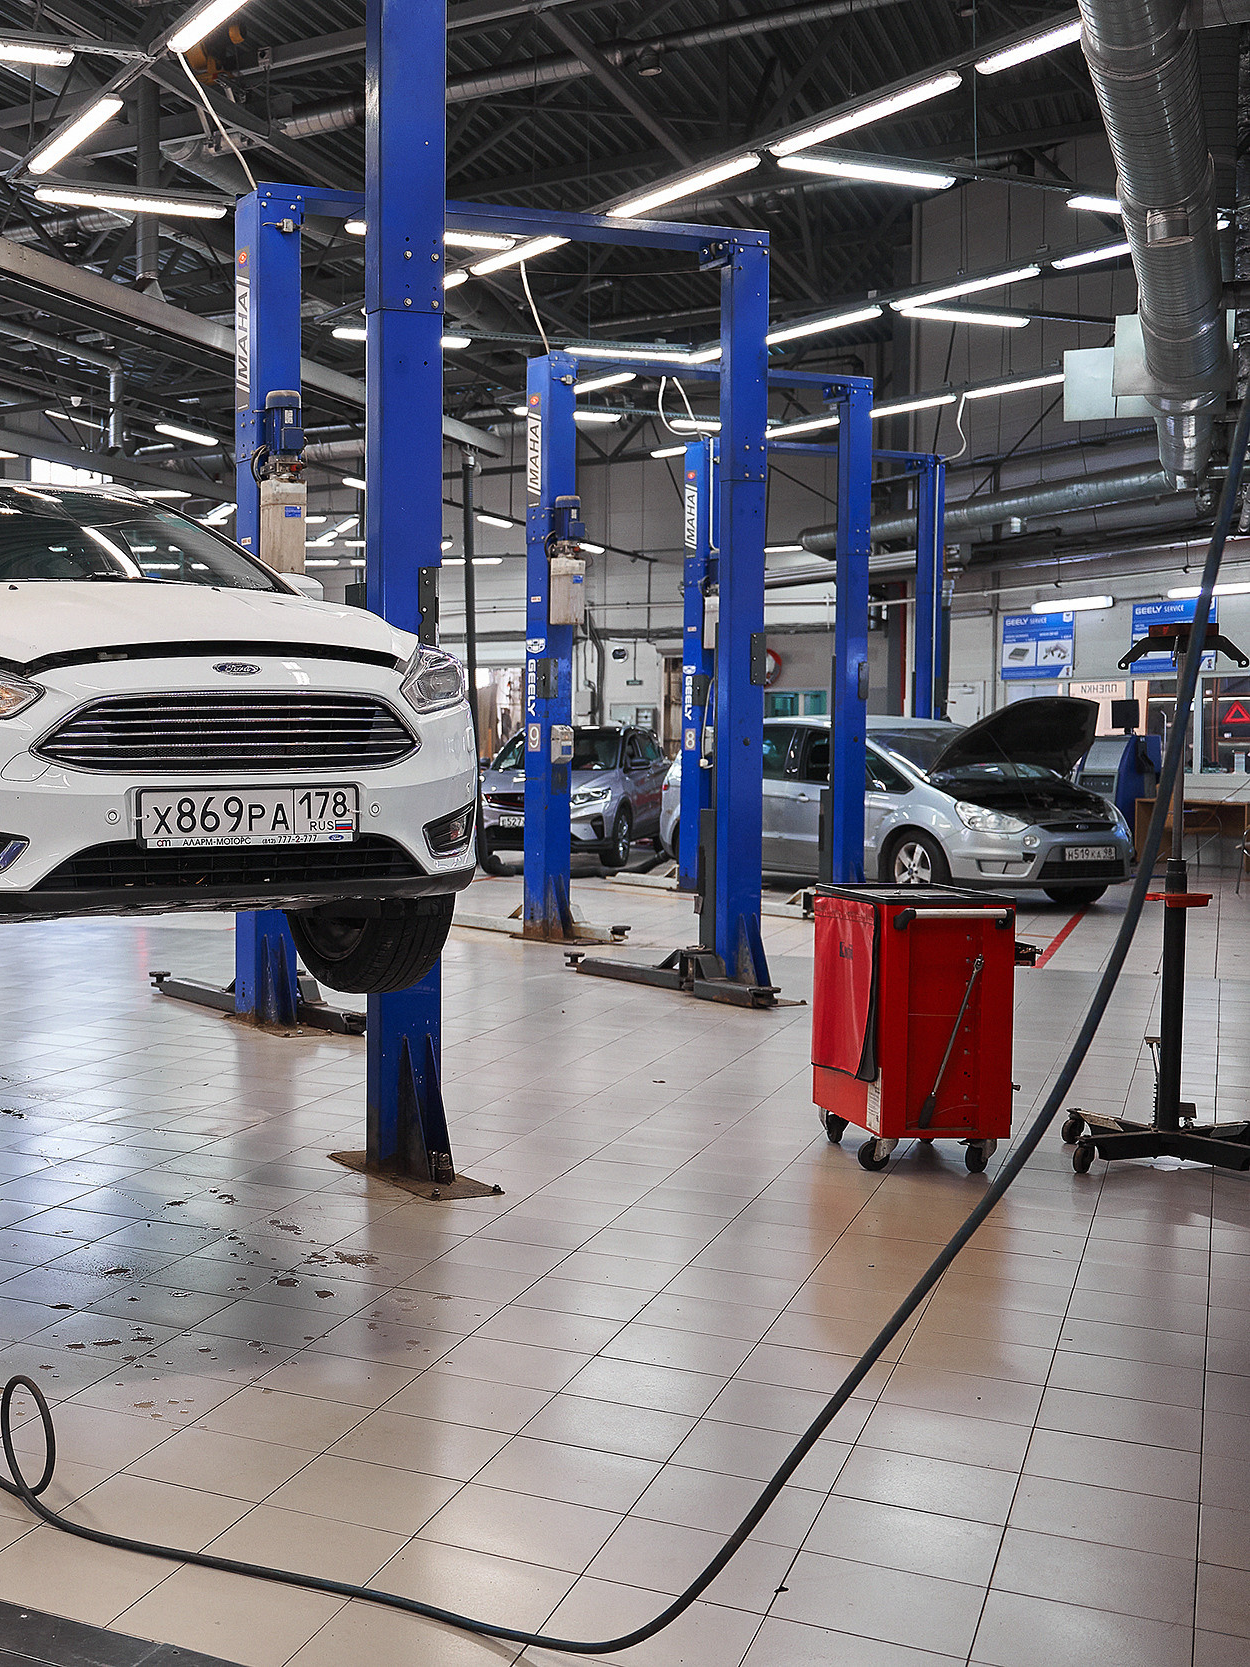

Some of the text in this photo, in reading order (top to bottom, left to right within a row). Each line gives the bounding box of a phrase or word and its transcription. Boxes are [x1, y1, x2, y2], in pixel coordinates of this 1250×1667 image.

[238, 292, 248, 379] MAHA
[530, 425, 539, 485] MAHA
[687, 495, 695, 541] MAHA
[1005, 617, 1029, 626] GEELY
[1135, 604, 1184, 615] GEELY SERVICE
[528, 659, 536, 717] GEELY
[685, 676, 693, 720] GEELY
[529, 726, 539, 748] 9
[686, 731, 695, 749] 8
[298, 791, 348, 819] 178
[309, 820, 334, 831] RUS
[277, 834, 318, 844] 777-2-777
